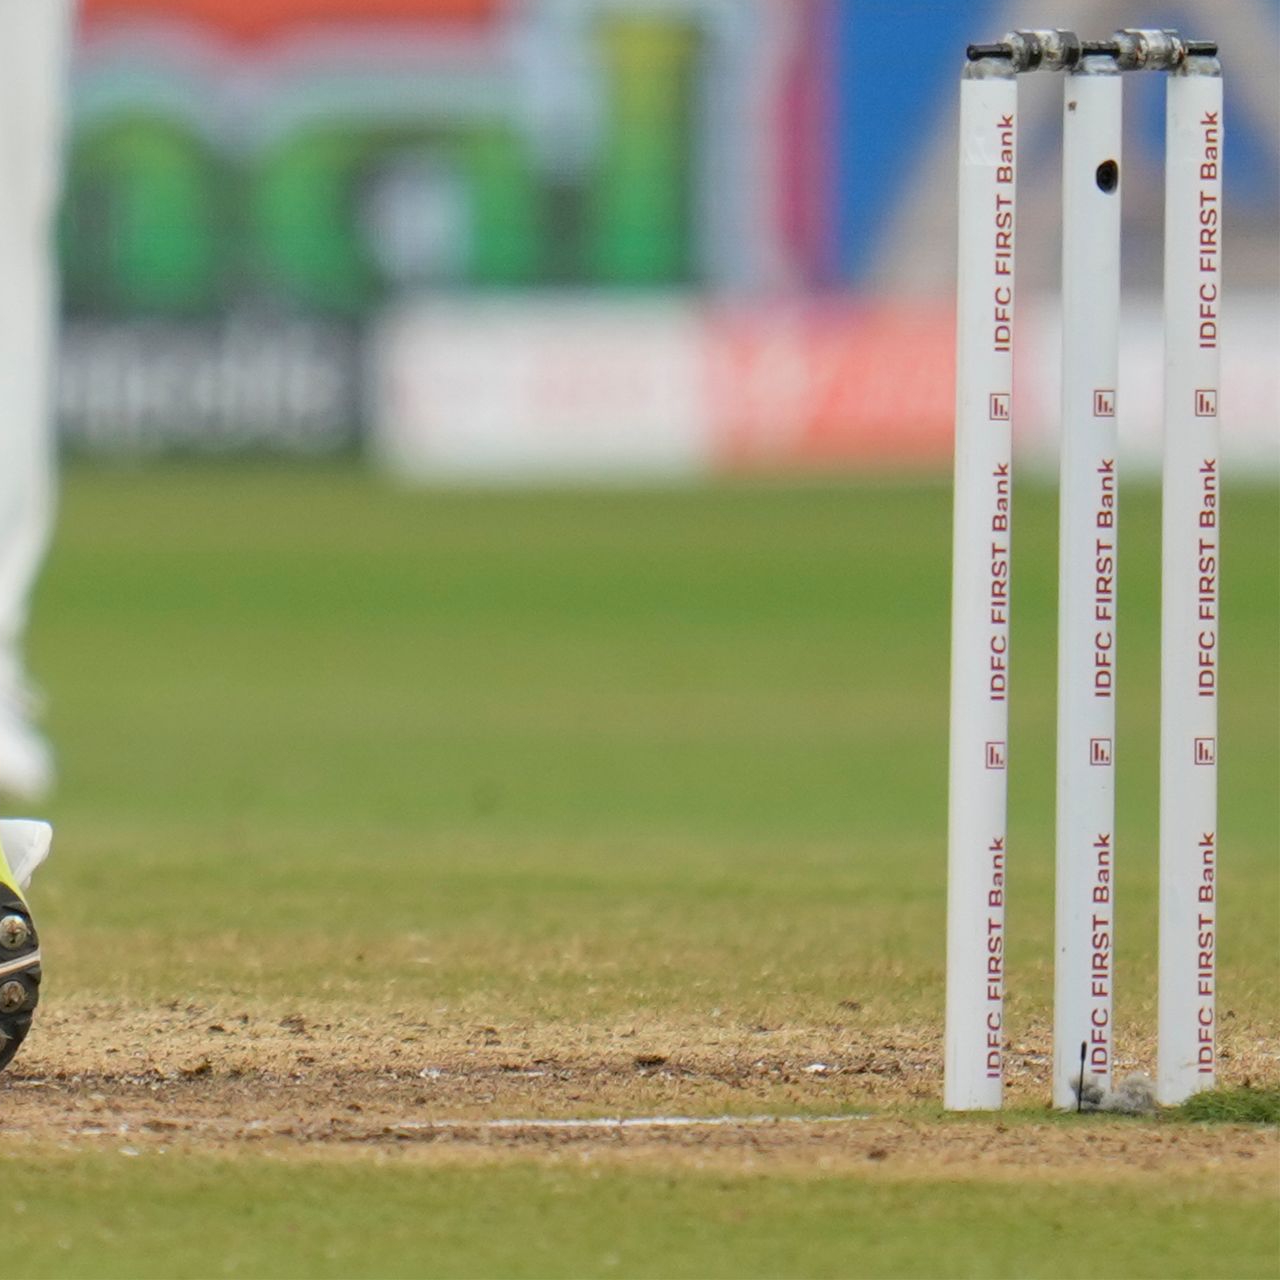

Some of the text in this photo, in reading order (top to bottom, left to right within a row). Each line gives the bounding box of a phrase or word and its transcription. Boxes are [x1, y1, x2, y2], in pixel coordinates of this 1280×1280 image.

[995, 115, 1014, 351] IDFC FIRST Bank
[1200, 112, 1218, 349] IDFC FIRST Bank
[991, 464, 1009, 701] IDFC FIRST Bank
[1096, 459, 1114, 696] IDFC FIRST Bank
[1199, 459, 1217, 695] IDFC FIRST Bank
[987, 837, 1005, 1077] IDFC FIRST Bank
[1092, 833, 1111, 1073] IDFC FIRST Bank
[1199, 833, 1214, 1072] IDFC FIRST Bank
